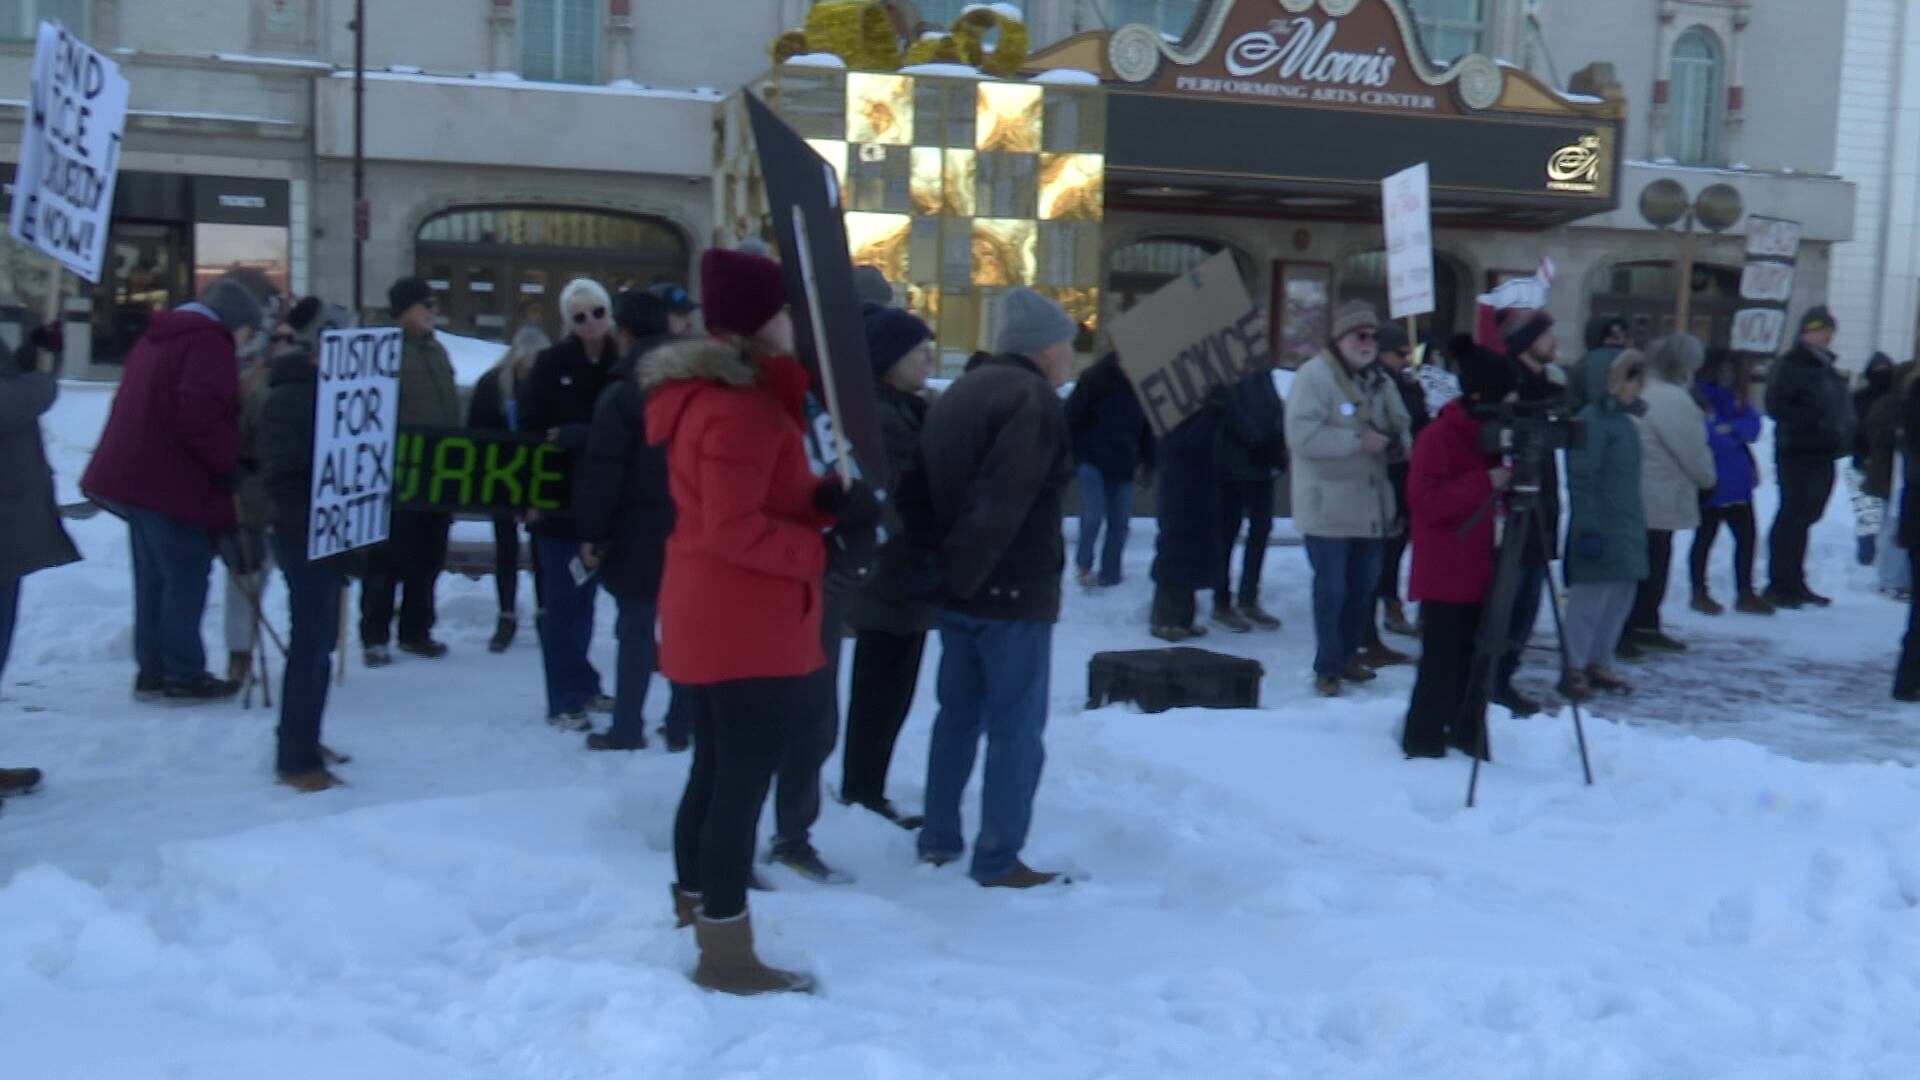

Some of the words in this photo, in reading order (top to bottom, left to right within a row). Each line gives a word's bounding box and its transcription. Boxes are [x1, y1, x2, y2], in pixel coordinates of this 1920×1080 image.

[54, 30, 105, 100] END
[1225, 16, 1396, 88] Morris
[51, 85, 91, 158] ICE
[1176, 75, 1308, 99] PERFORMING
[1311, 87, 1356, 104] ARTS
[1360, 90, 1436, 109] CENTER
[320, 332, 400, 382] JUSTICE
[334, 387, 384, 439] FOR
[316, 441, 390, 499] ALEX
[314, 492, 390, 555] PRETTI
